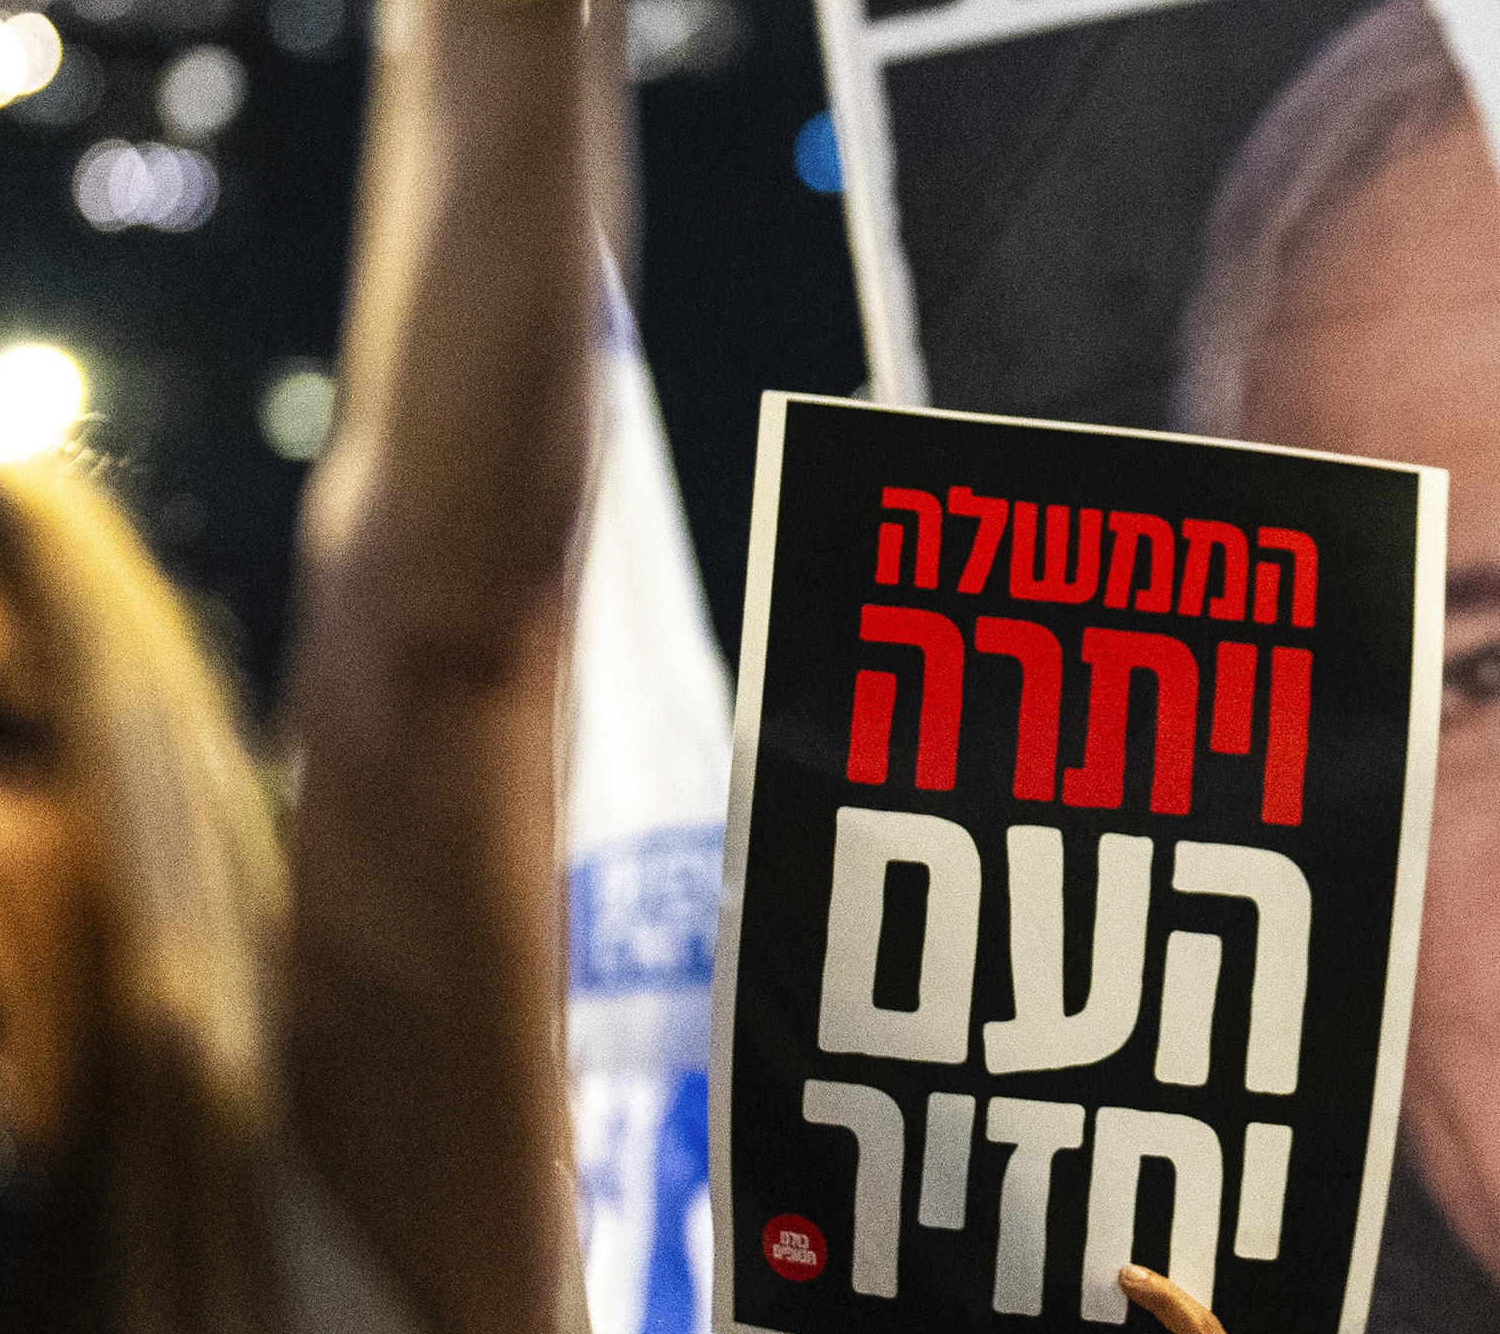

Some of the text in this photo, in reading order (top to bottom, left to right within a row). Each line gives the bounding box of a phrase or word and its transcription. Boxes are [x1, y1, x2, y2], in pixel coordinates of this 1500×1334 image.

[874, 485, 1319, 629] הממשלה
[846, 603, 1314, 827] ויתרה
[817, 805, 1313, 1097] העם
[802, 1078, 1294, 1326] יחזיר
